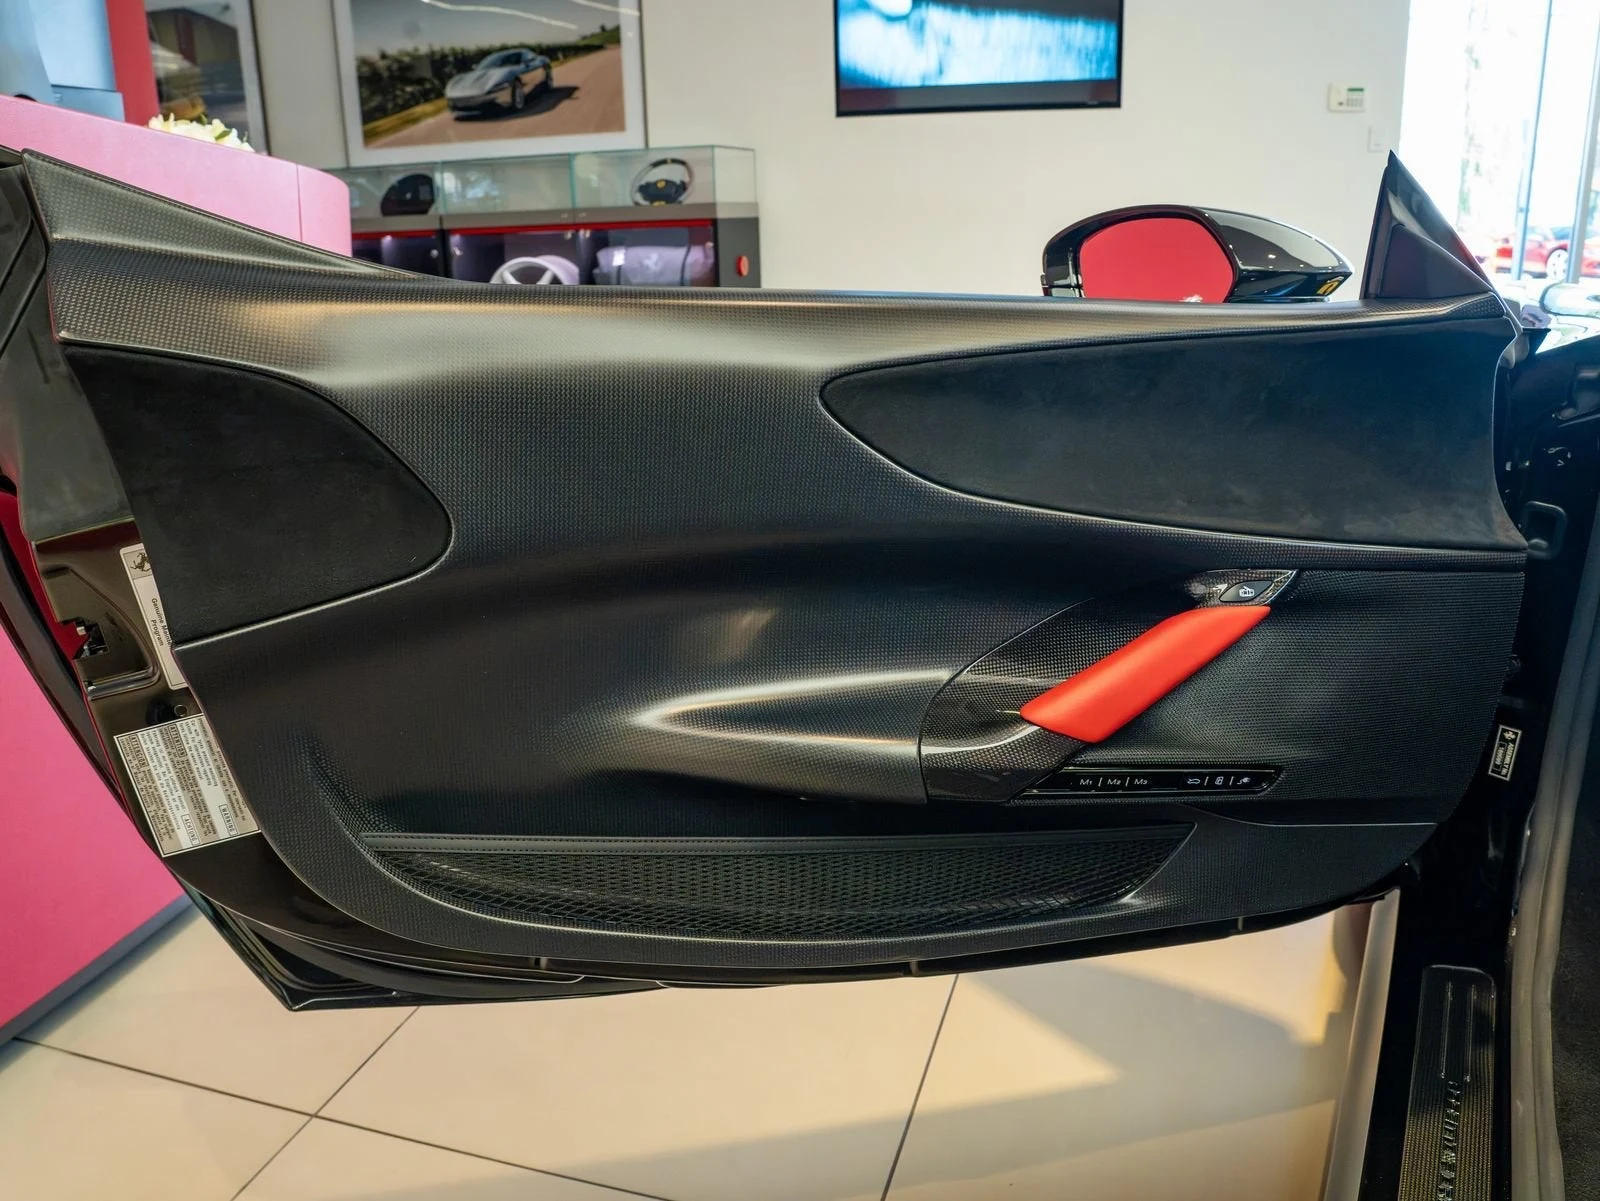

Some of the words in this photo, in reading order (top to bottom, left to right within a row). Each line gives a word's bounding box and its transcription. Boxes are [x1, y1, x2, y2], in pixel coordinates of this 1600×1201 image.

[150, 597, 165, 624] Genuine
[150, 619, 164, 646] Program
[169, 726, 185, 756] ATTENTION
[221, 807, 235, 832] WARNING
